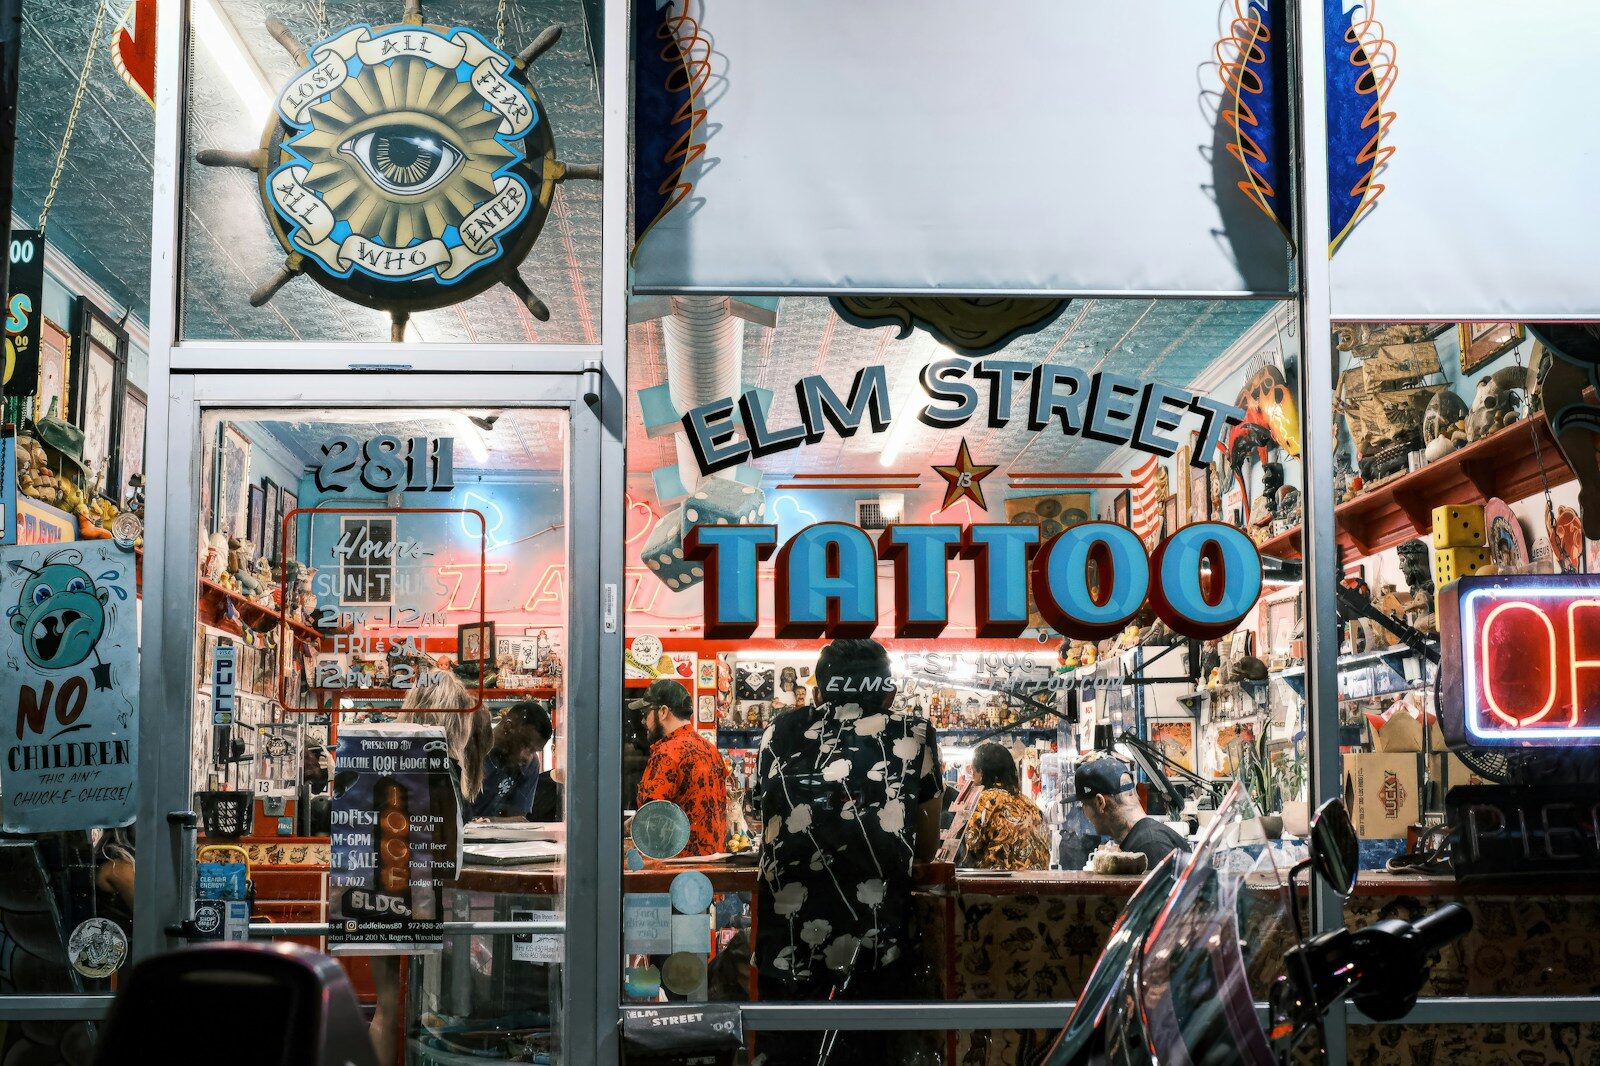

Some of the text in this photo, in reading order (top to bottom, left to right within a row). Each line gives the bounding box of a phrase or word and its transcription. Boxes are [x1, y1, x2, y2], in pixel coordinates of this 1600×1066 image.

[286, 34, 529, 125] LOSE ALL FEAR
[276, 183, 524, 270] ALL WHO ENTER
[681, 357, 1244, 476] ELM STREET
[315, 435, 454, 493] 2811
[957, 472, 972, 488] 13
[331, 525, 435, 560] Hours
[317, 573, 449, 597] SUN-THUS
[683, 520, 1262, 640] TATTOO
[334, 634, 371, 657] FRI
[388, 634, 429, 657] SAT
[974, 652, 1038, 674] 1996
[215, 659, 232, 712] PULL
[16, 675, 88, 741] NO
[8, 740, 130, 772] CHILDREN
[39, 770, 102, 785] THIS AIN'T
[258, 781, 270, 793] 13
[13, 782, 133, 807] CHUCK-E-CHEESE!
[1384, 770, 1398, 819] LUCKY
[409, 824, 435, 832] For All
[429, 815, 444, 823] Fun
[1468, 802, 1600, 862] PIE
[409, 842, 448, 850] Craft Beer
[409, 860, 455, 868] Food Trucks
[408, 879, 431, 888] Lodge
[351, 890, 412, 916] BLDG.
[629, 1010, 658, 1019] ELM
[652, 1012, 704, 1027] STREET
